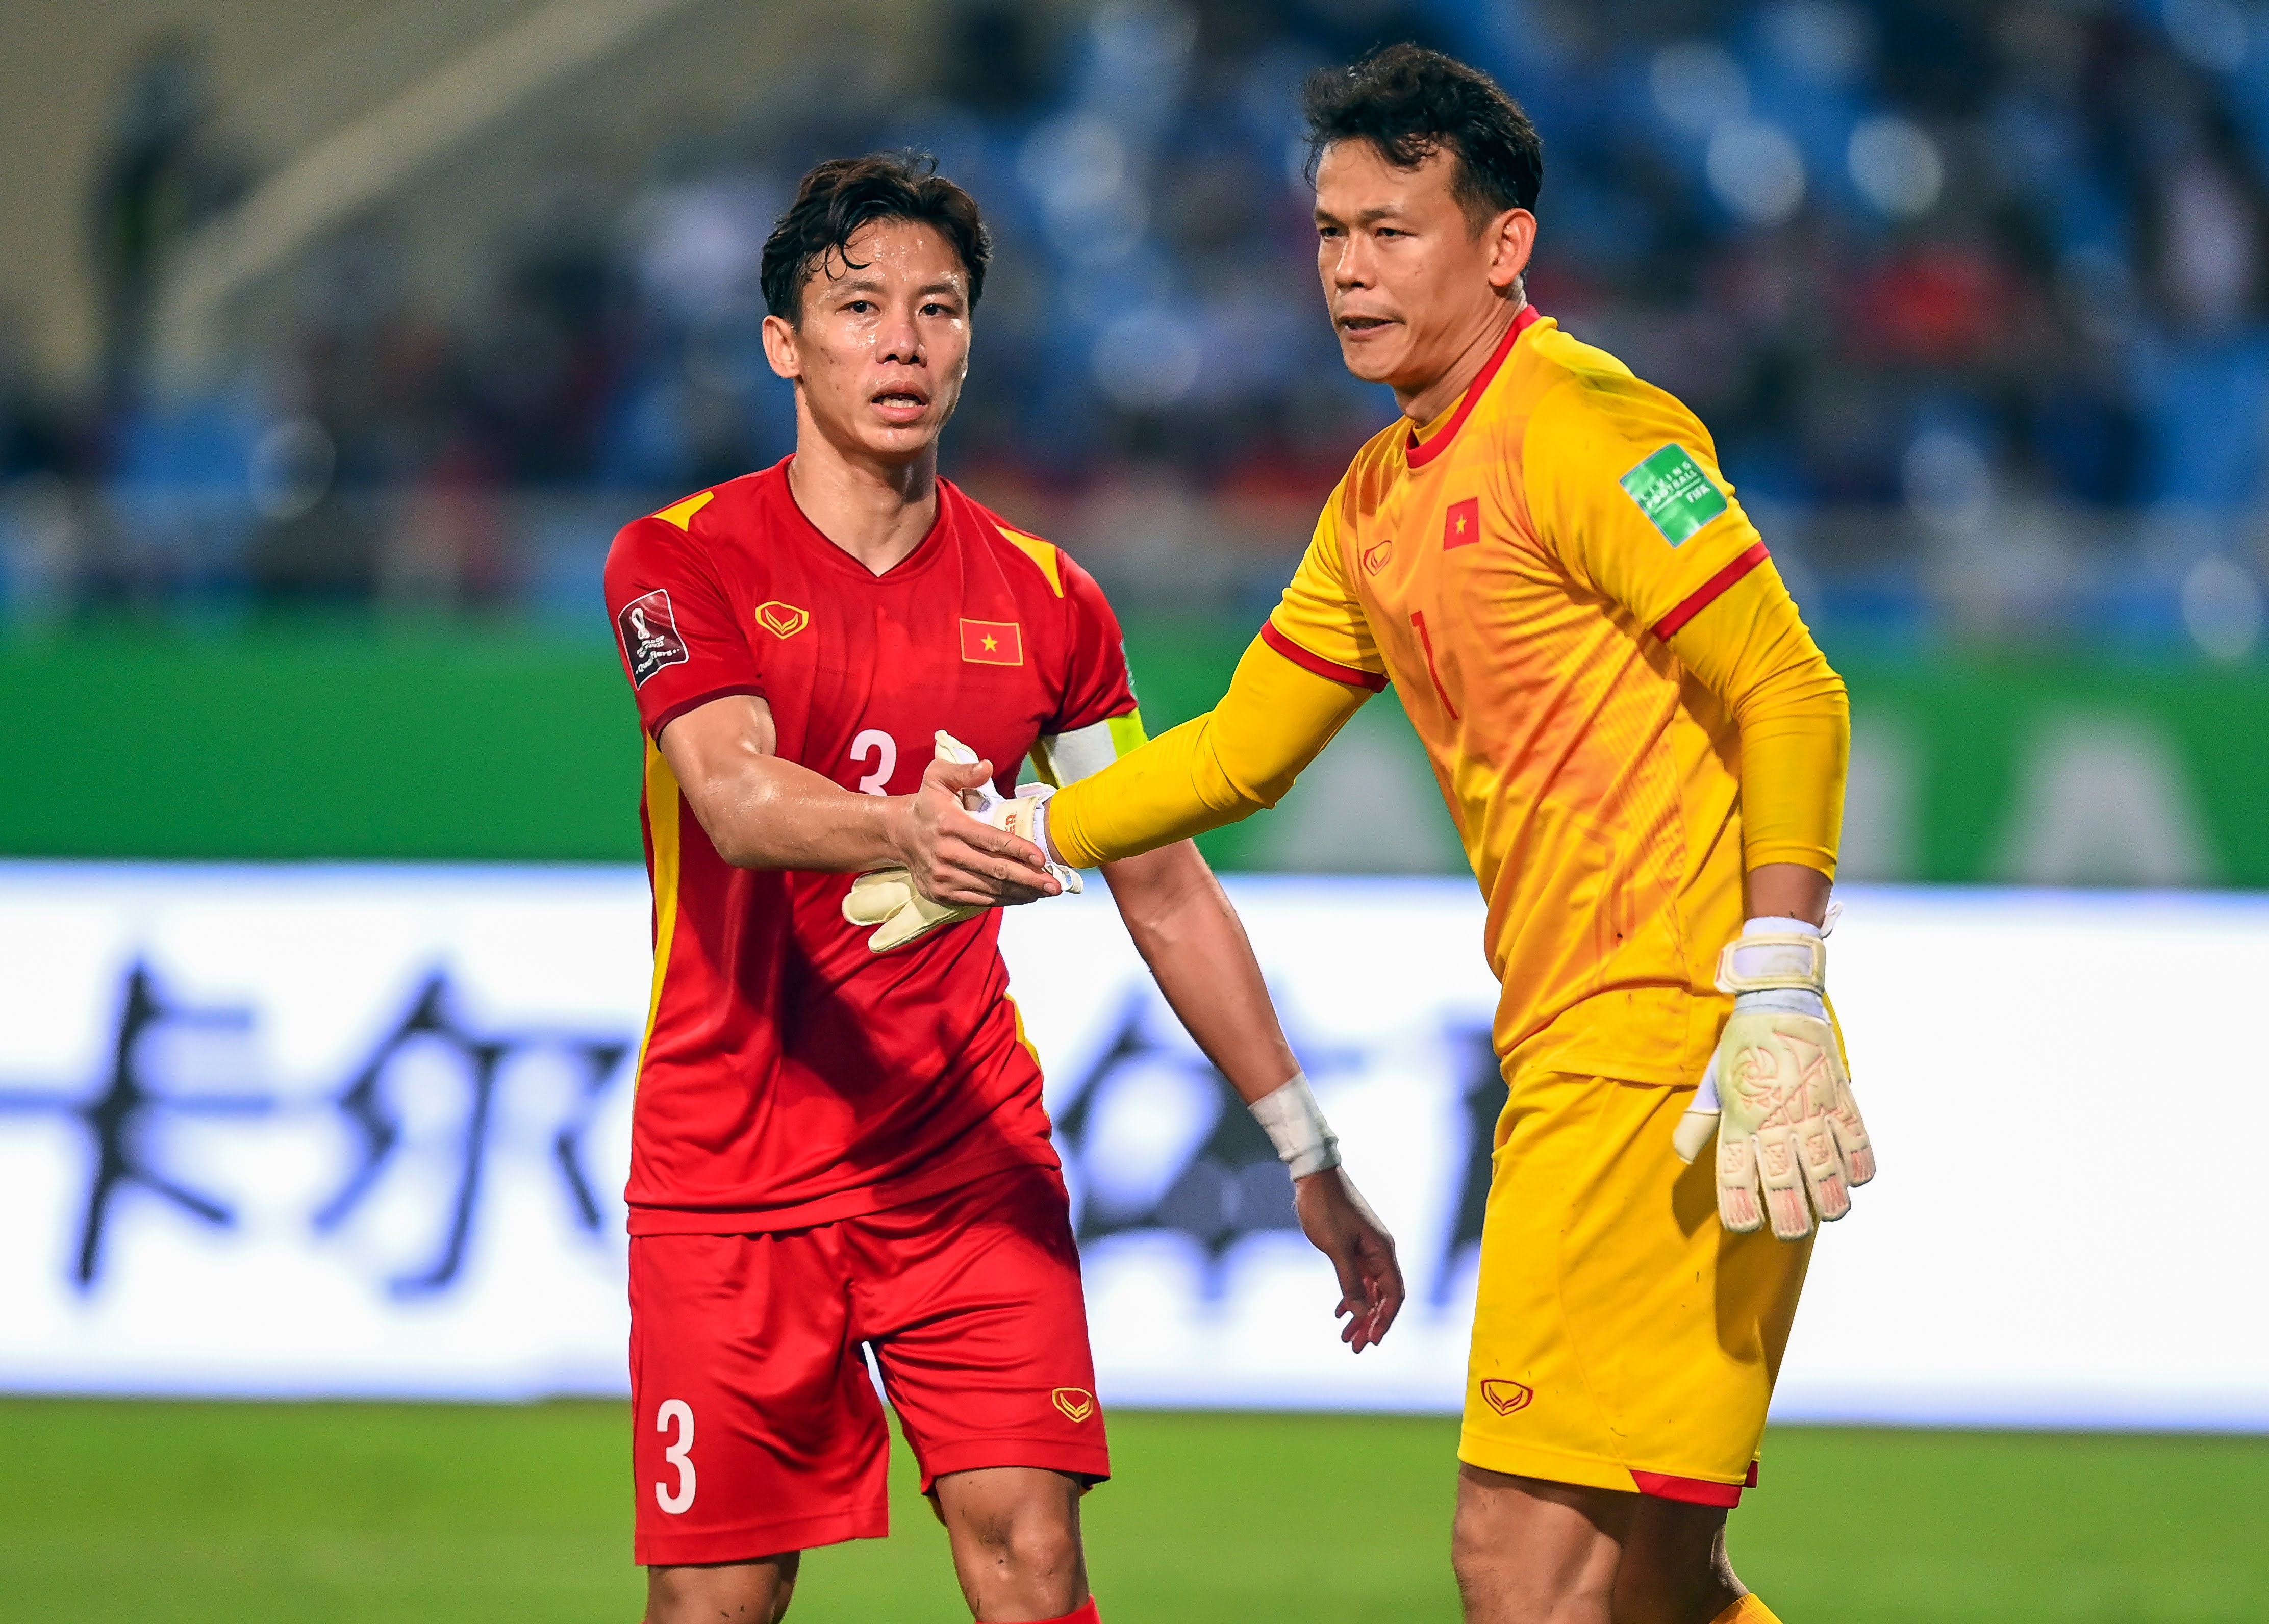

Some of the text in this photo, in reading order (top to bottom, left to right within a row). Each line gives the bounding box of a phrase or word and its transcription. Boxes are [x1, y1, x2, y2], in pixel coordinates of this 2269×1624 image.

[1411, 610, 1458, 720] 1
[850, 729, 896, 796] 3
[656, 1399, 696, 1515] 3
